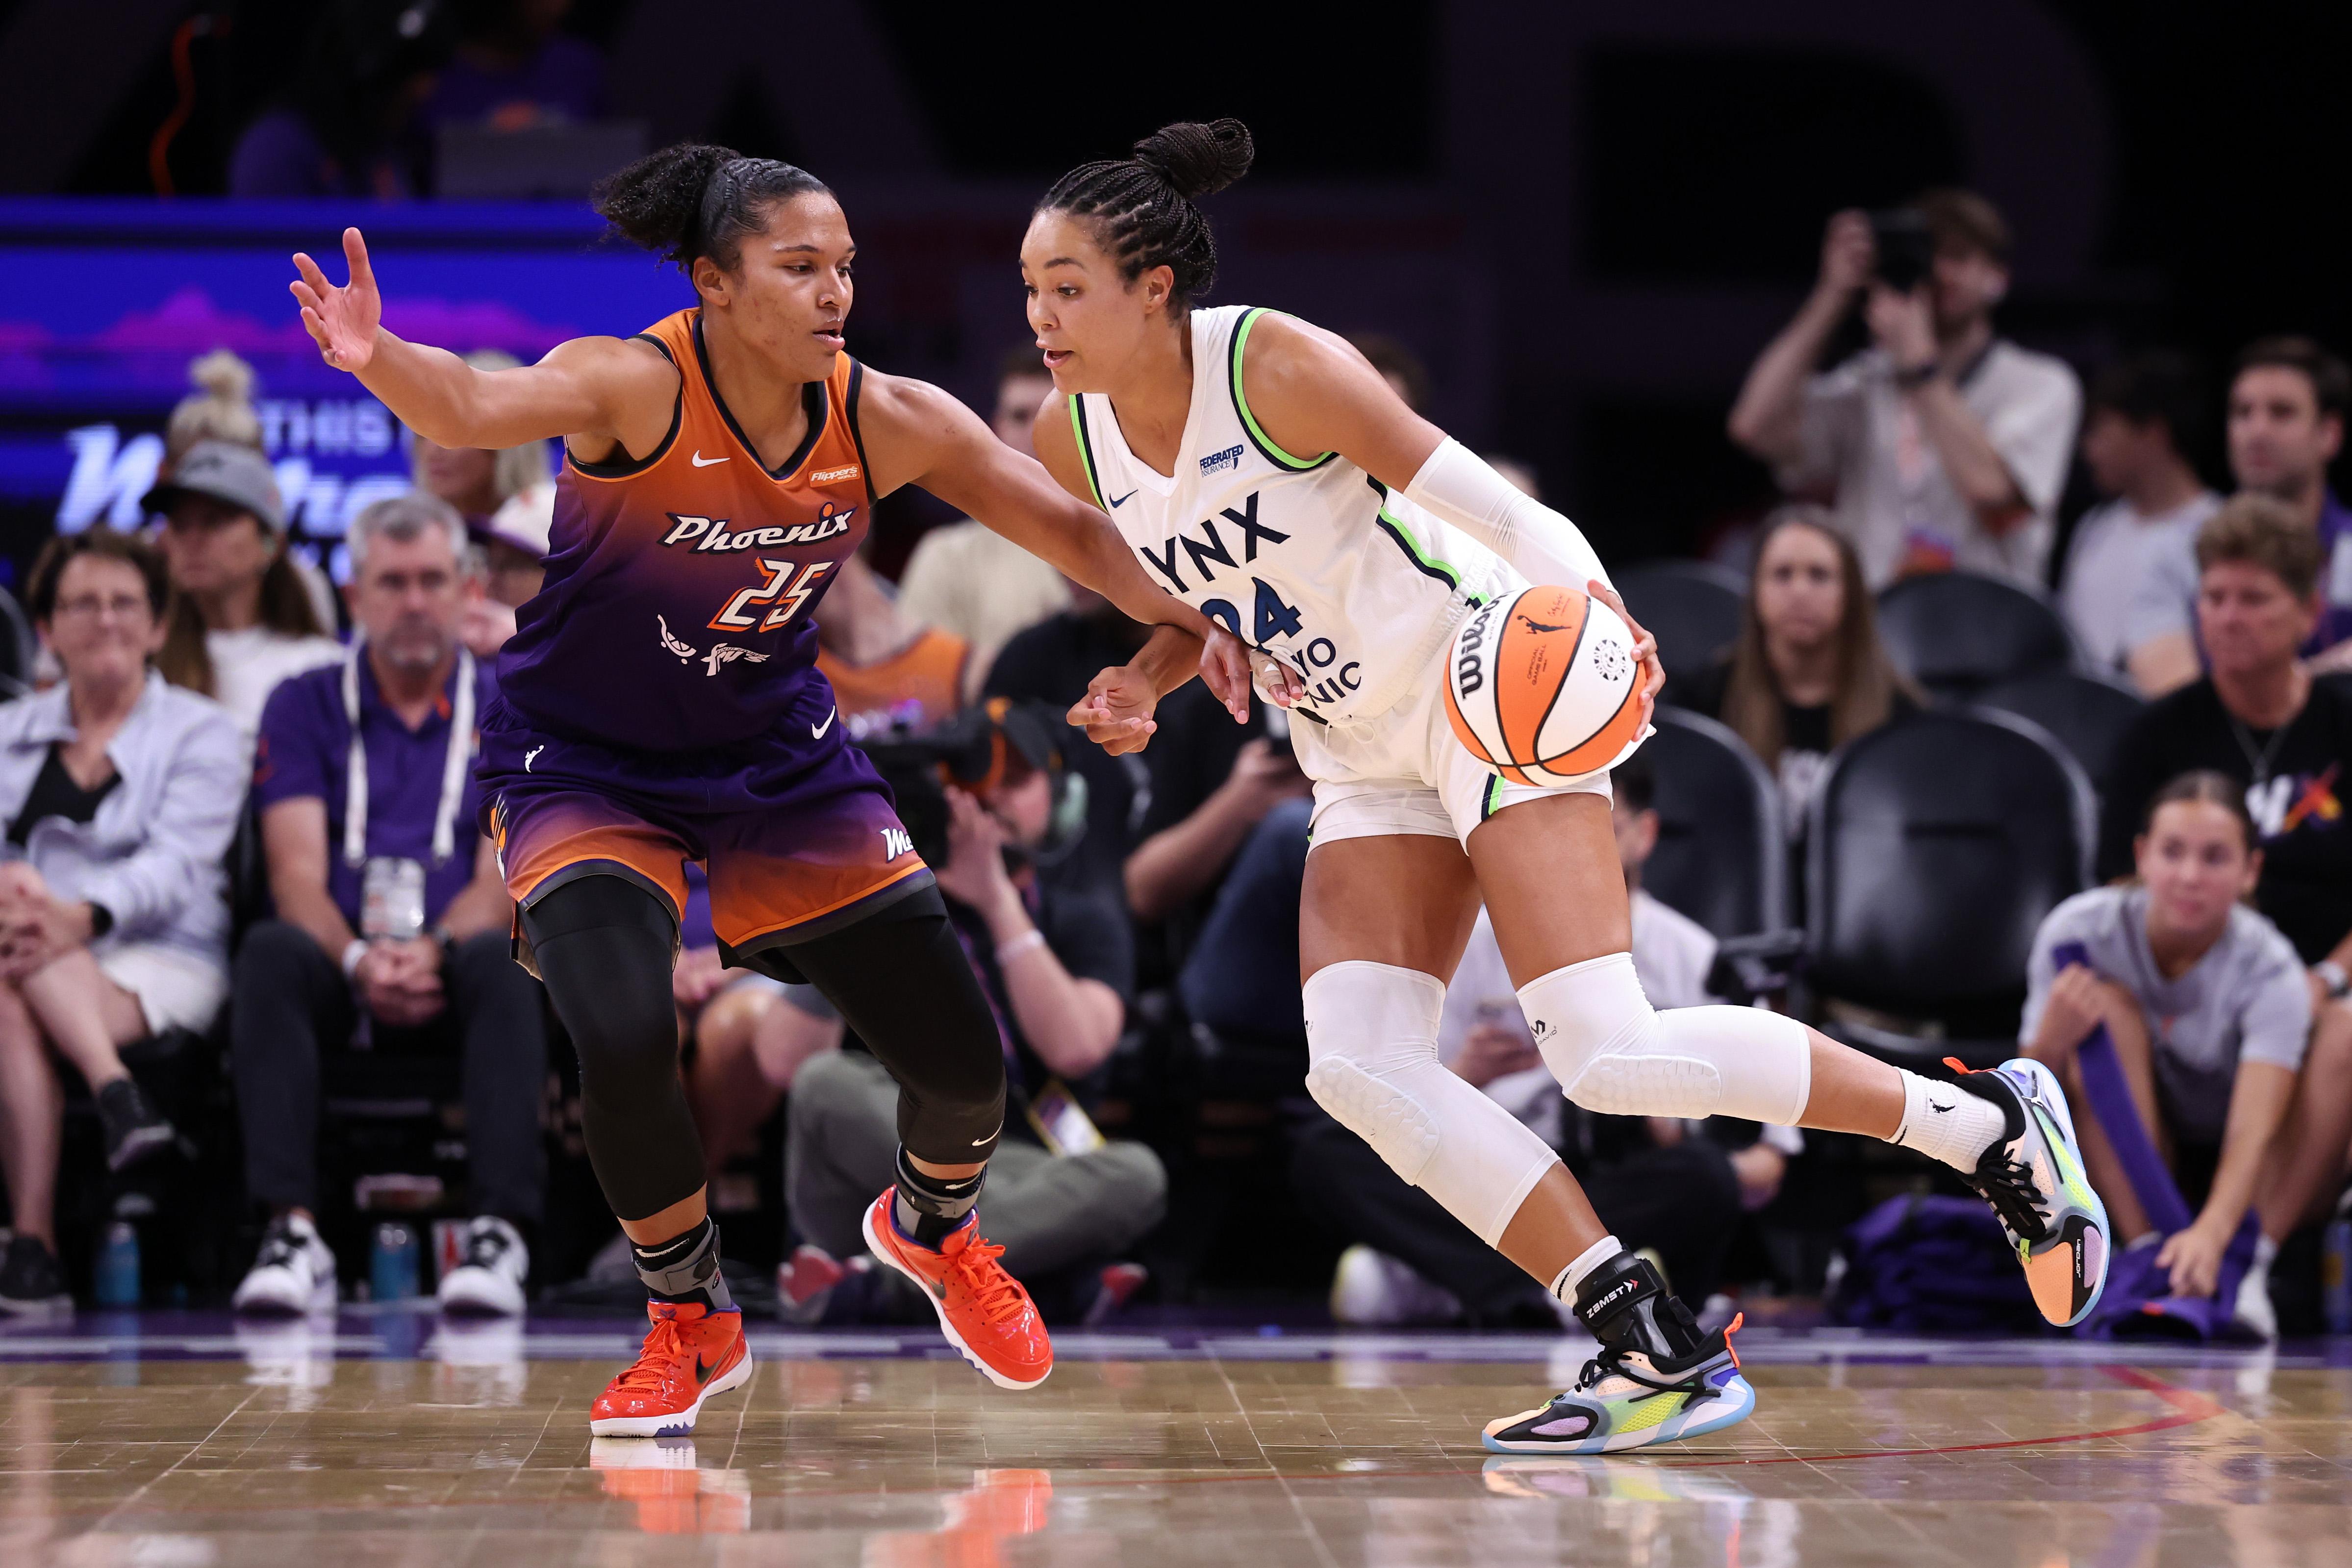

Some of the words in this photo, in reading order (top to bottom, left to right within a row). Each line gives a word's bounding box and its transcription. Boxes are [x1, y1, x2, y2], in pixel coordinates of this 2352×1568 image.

[1199, 444, 1243, 470] FEDERATED
[1201, 460, 1230, 478] NSURANCE
[660, 502, 856, 553] Phoenix
[1139, 491, 1291, 595] YNX
[707, 557, 835, 632] 25
[1290, 637, 1336, 678] YO
[1538, 644, 1546, 662] BALL
[1305, 661, 1361, 708] NIC
